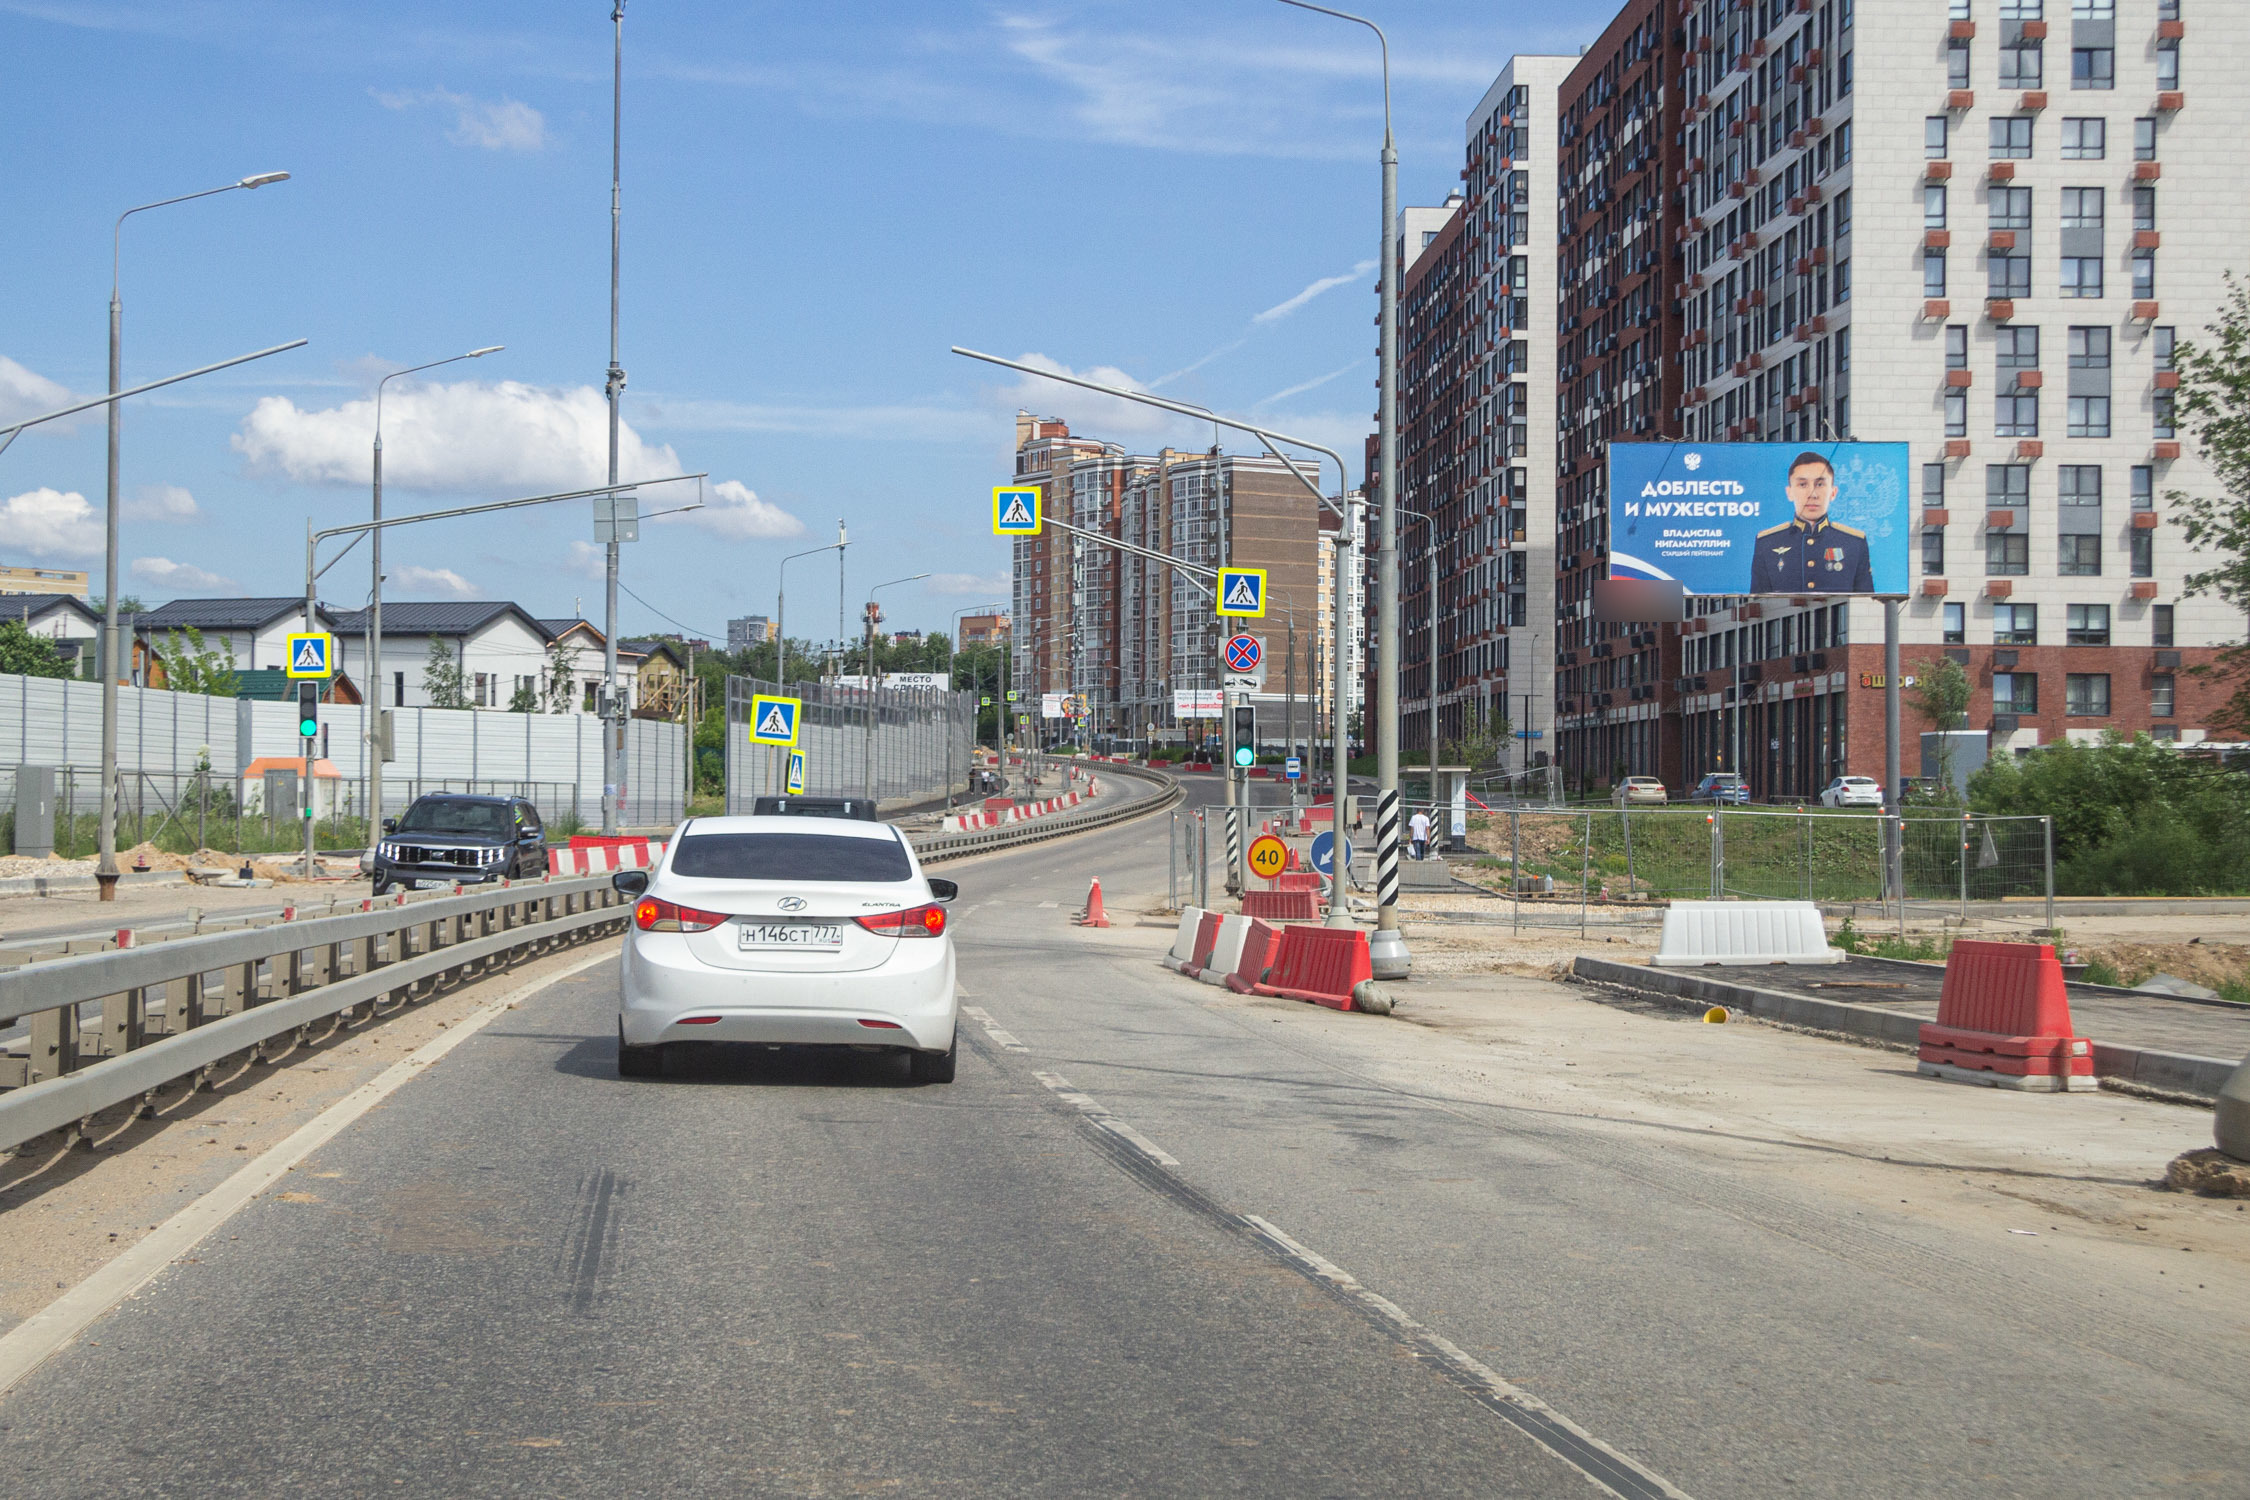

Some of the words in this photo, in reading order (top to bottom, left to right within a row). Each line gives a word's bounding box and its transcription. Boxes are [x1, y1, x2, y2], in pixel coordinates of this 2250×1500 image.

[1641, 480, 1744, 497] ДОБЛЕСТЬ
[1625, 502, 1639, 516] И
[1645, 502, 1760, 517] МУЖЕСТВО!
[1663, 529, 1723, 538] ВЛАДИСЛАВ
[1655, 539, 1731, 548] НИГАМАТУЛЛИН
[1661, 549, 1690, 557] СТАРШИЙ
[1872, 675, 1926, 688] ШОРЫ
[1256, 849, 1279, 865] 40
[813, 925, 838, 938] 777
